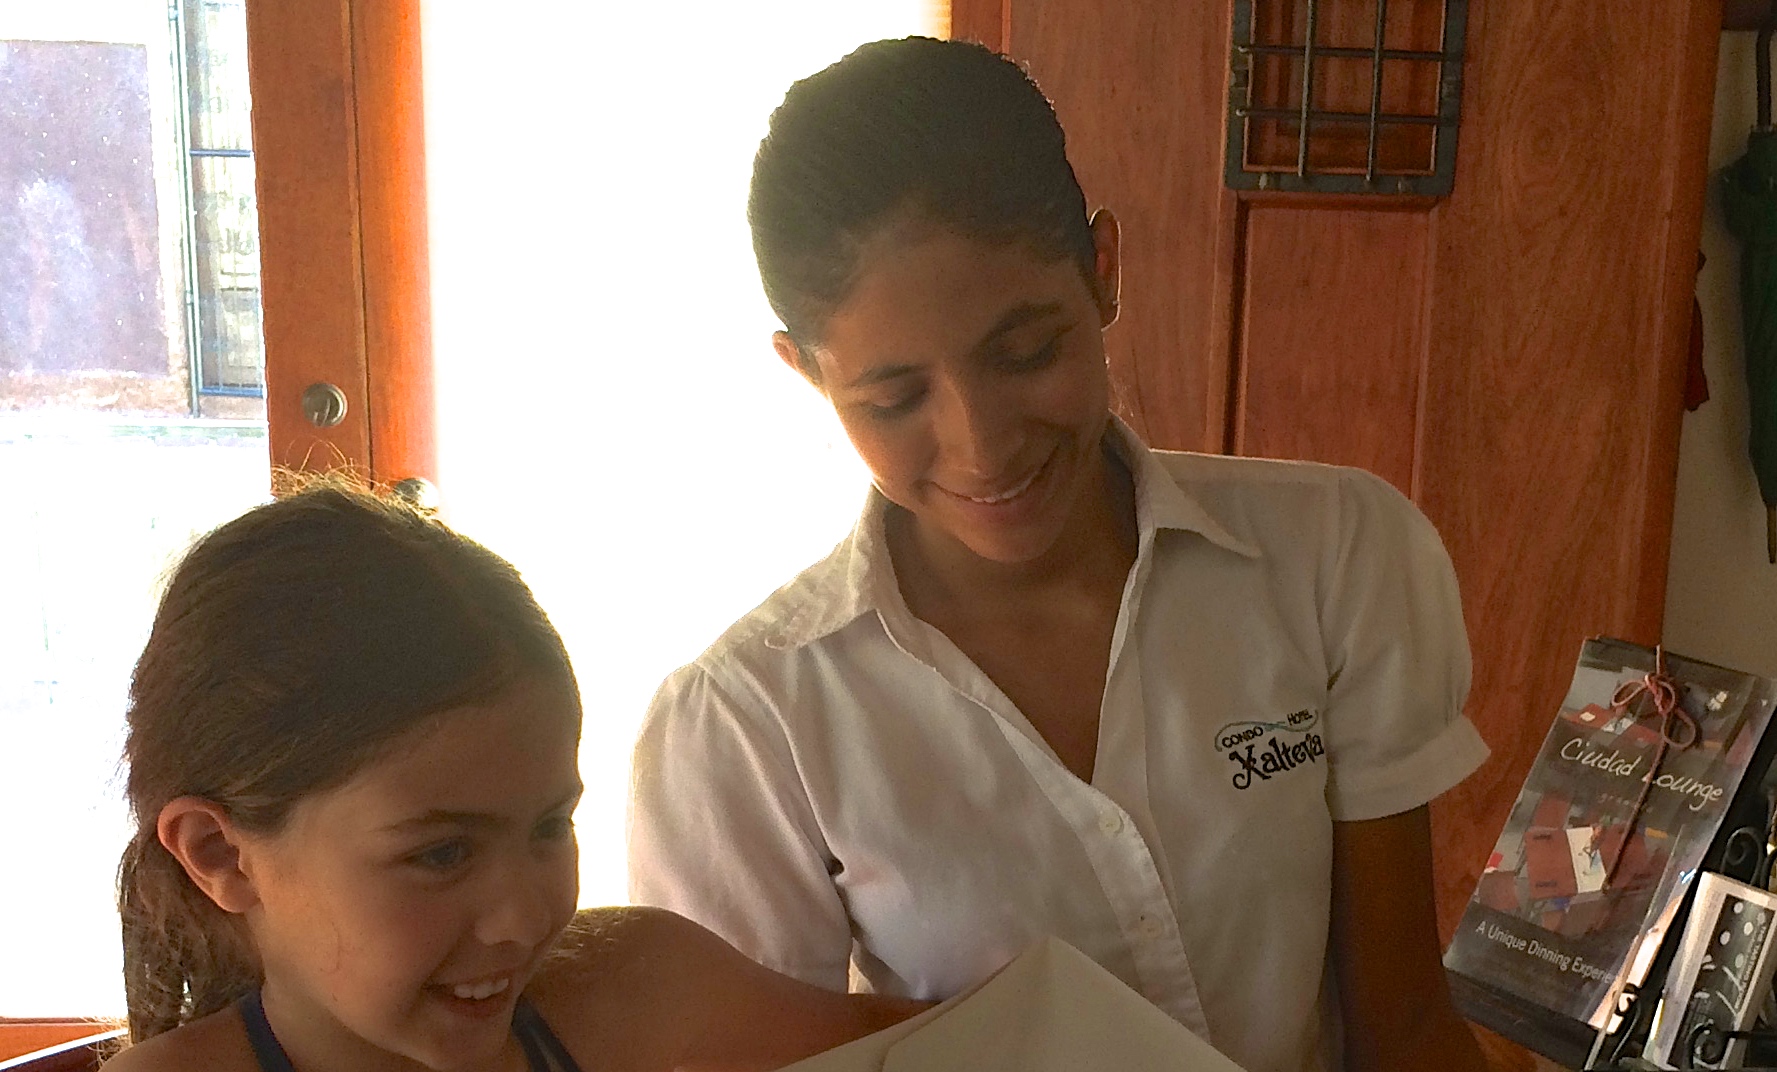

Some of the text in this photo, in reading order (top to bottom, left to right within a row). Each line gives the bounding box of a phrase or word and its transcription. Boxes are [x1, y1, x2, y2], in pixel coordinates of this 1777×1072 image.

[1221, 726, 1263, 748] CONDO
[1560, 737, 1640, 776] Ciudad
[1475, 920, 1487, 935] A
[1487, 924, 1527, 951] Unique
[1526, 939, 1571, 971] Dinning
